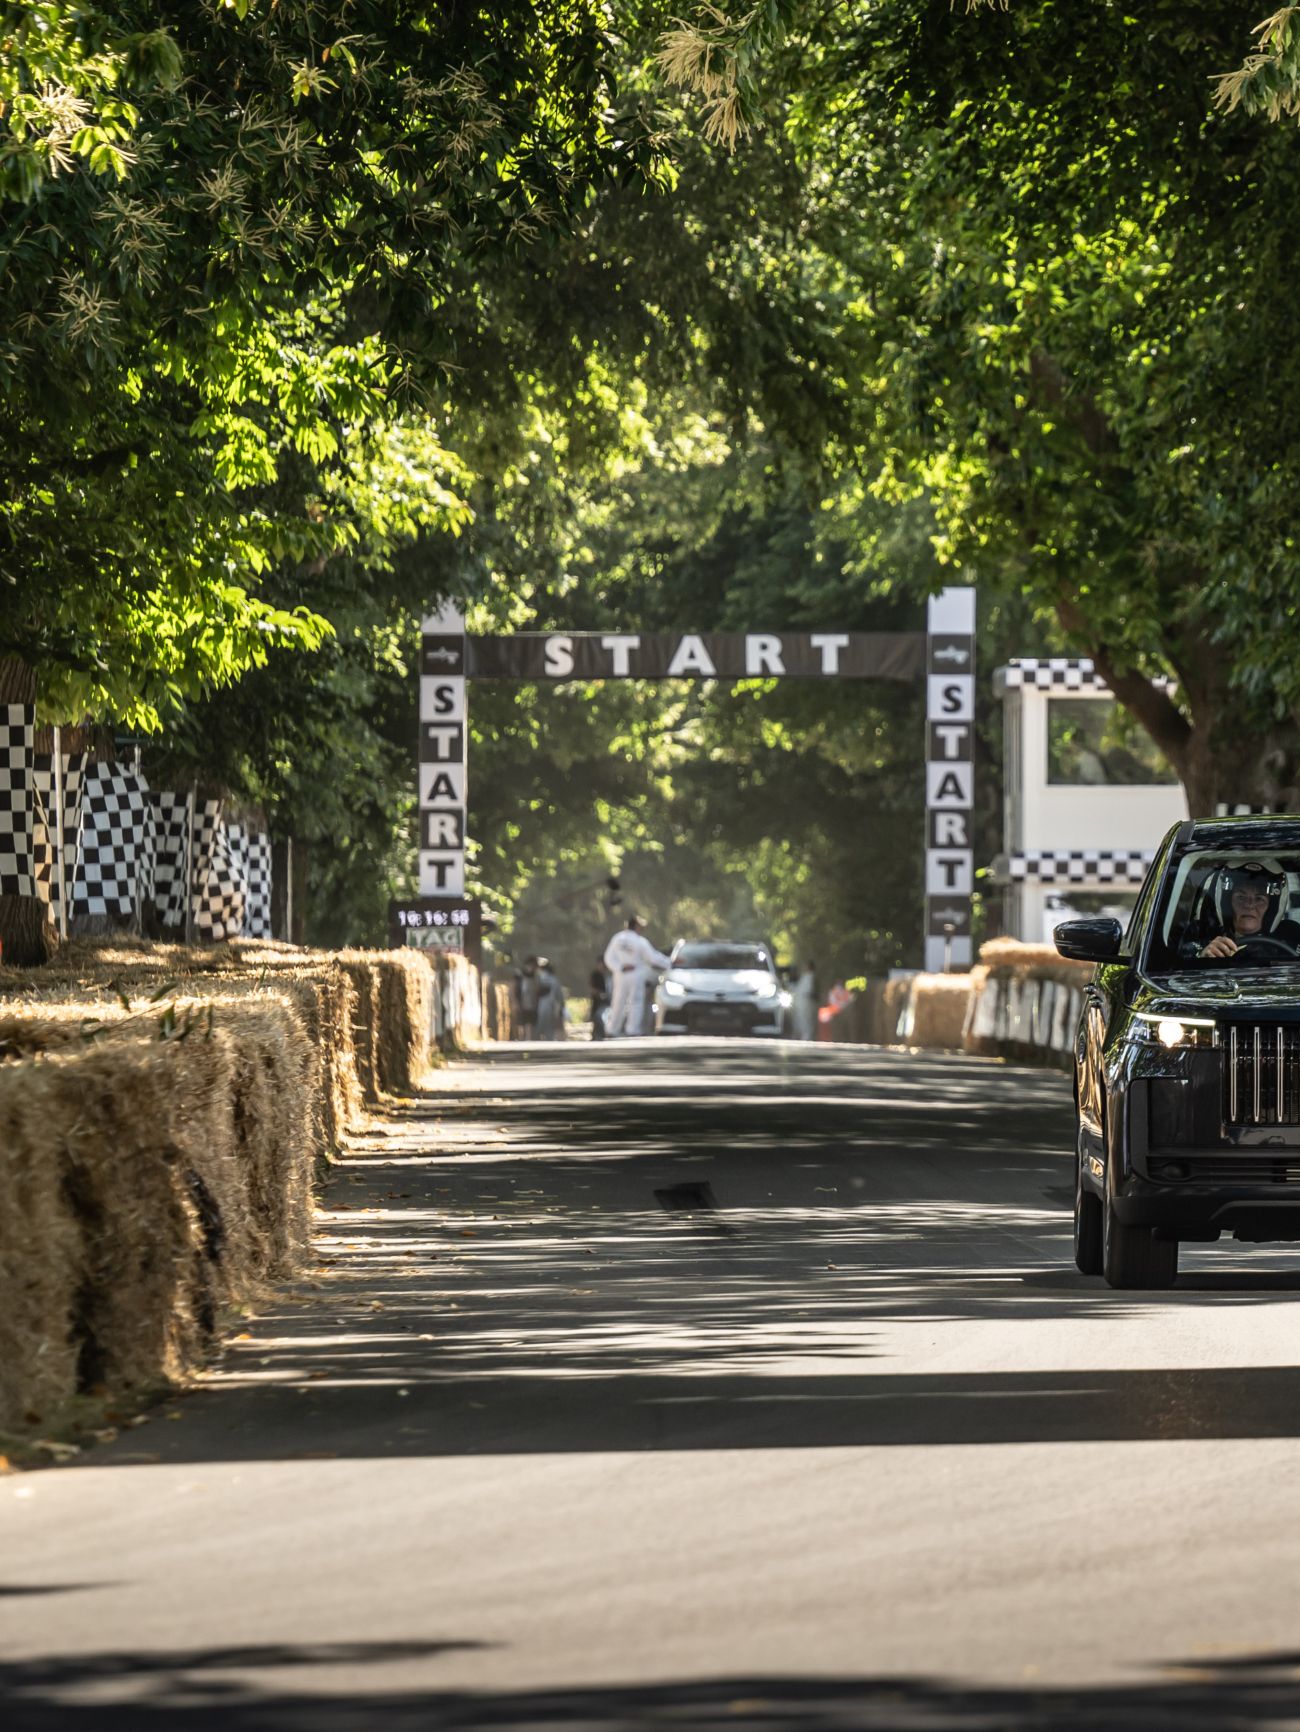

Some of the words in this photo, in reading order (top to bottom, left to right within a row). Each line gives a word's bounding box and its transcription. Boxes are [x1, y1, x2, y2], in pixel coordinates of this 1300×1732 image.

[544, 634, 849, 677] START
[427, 685, 459, 888] START
[935, 685, 968, 887] START
[411, 928, 458, 947] TAG
